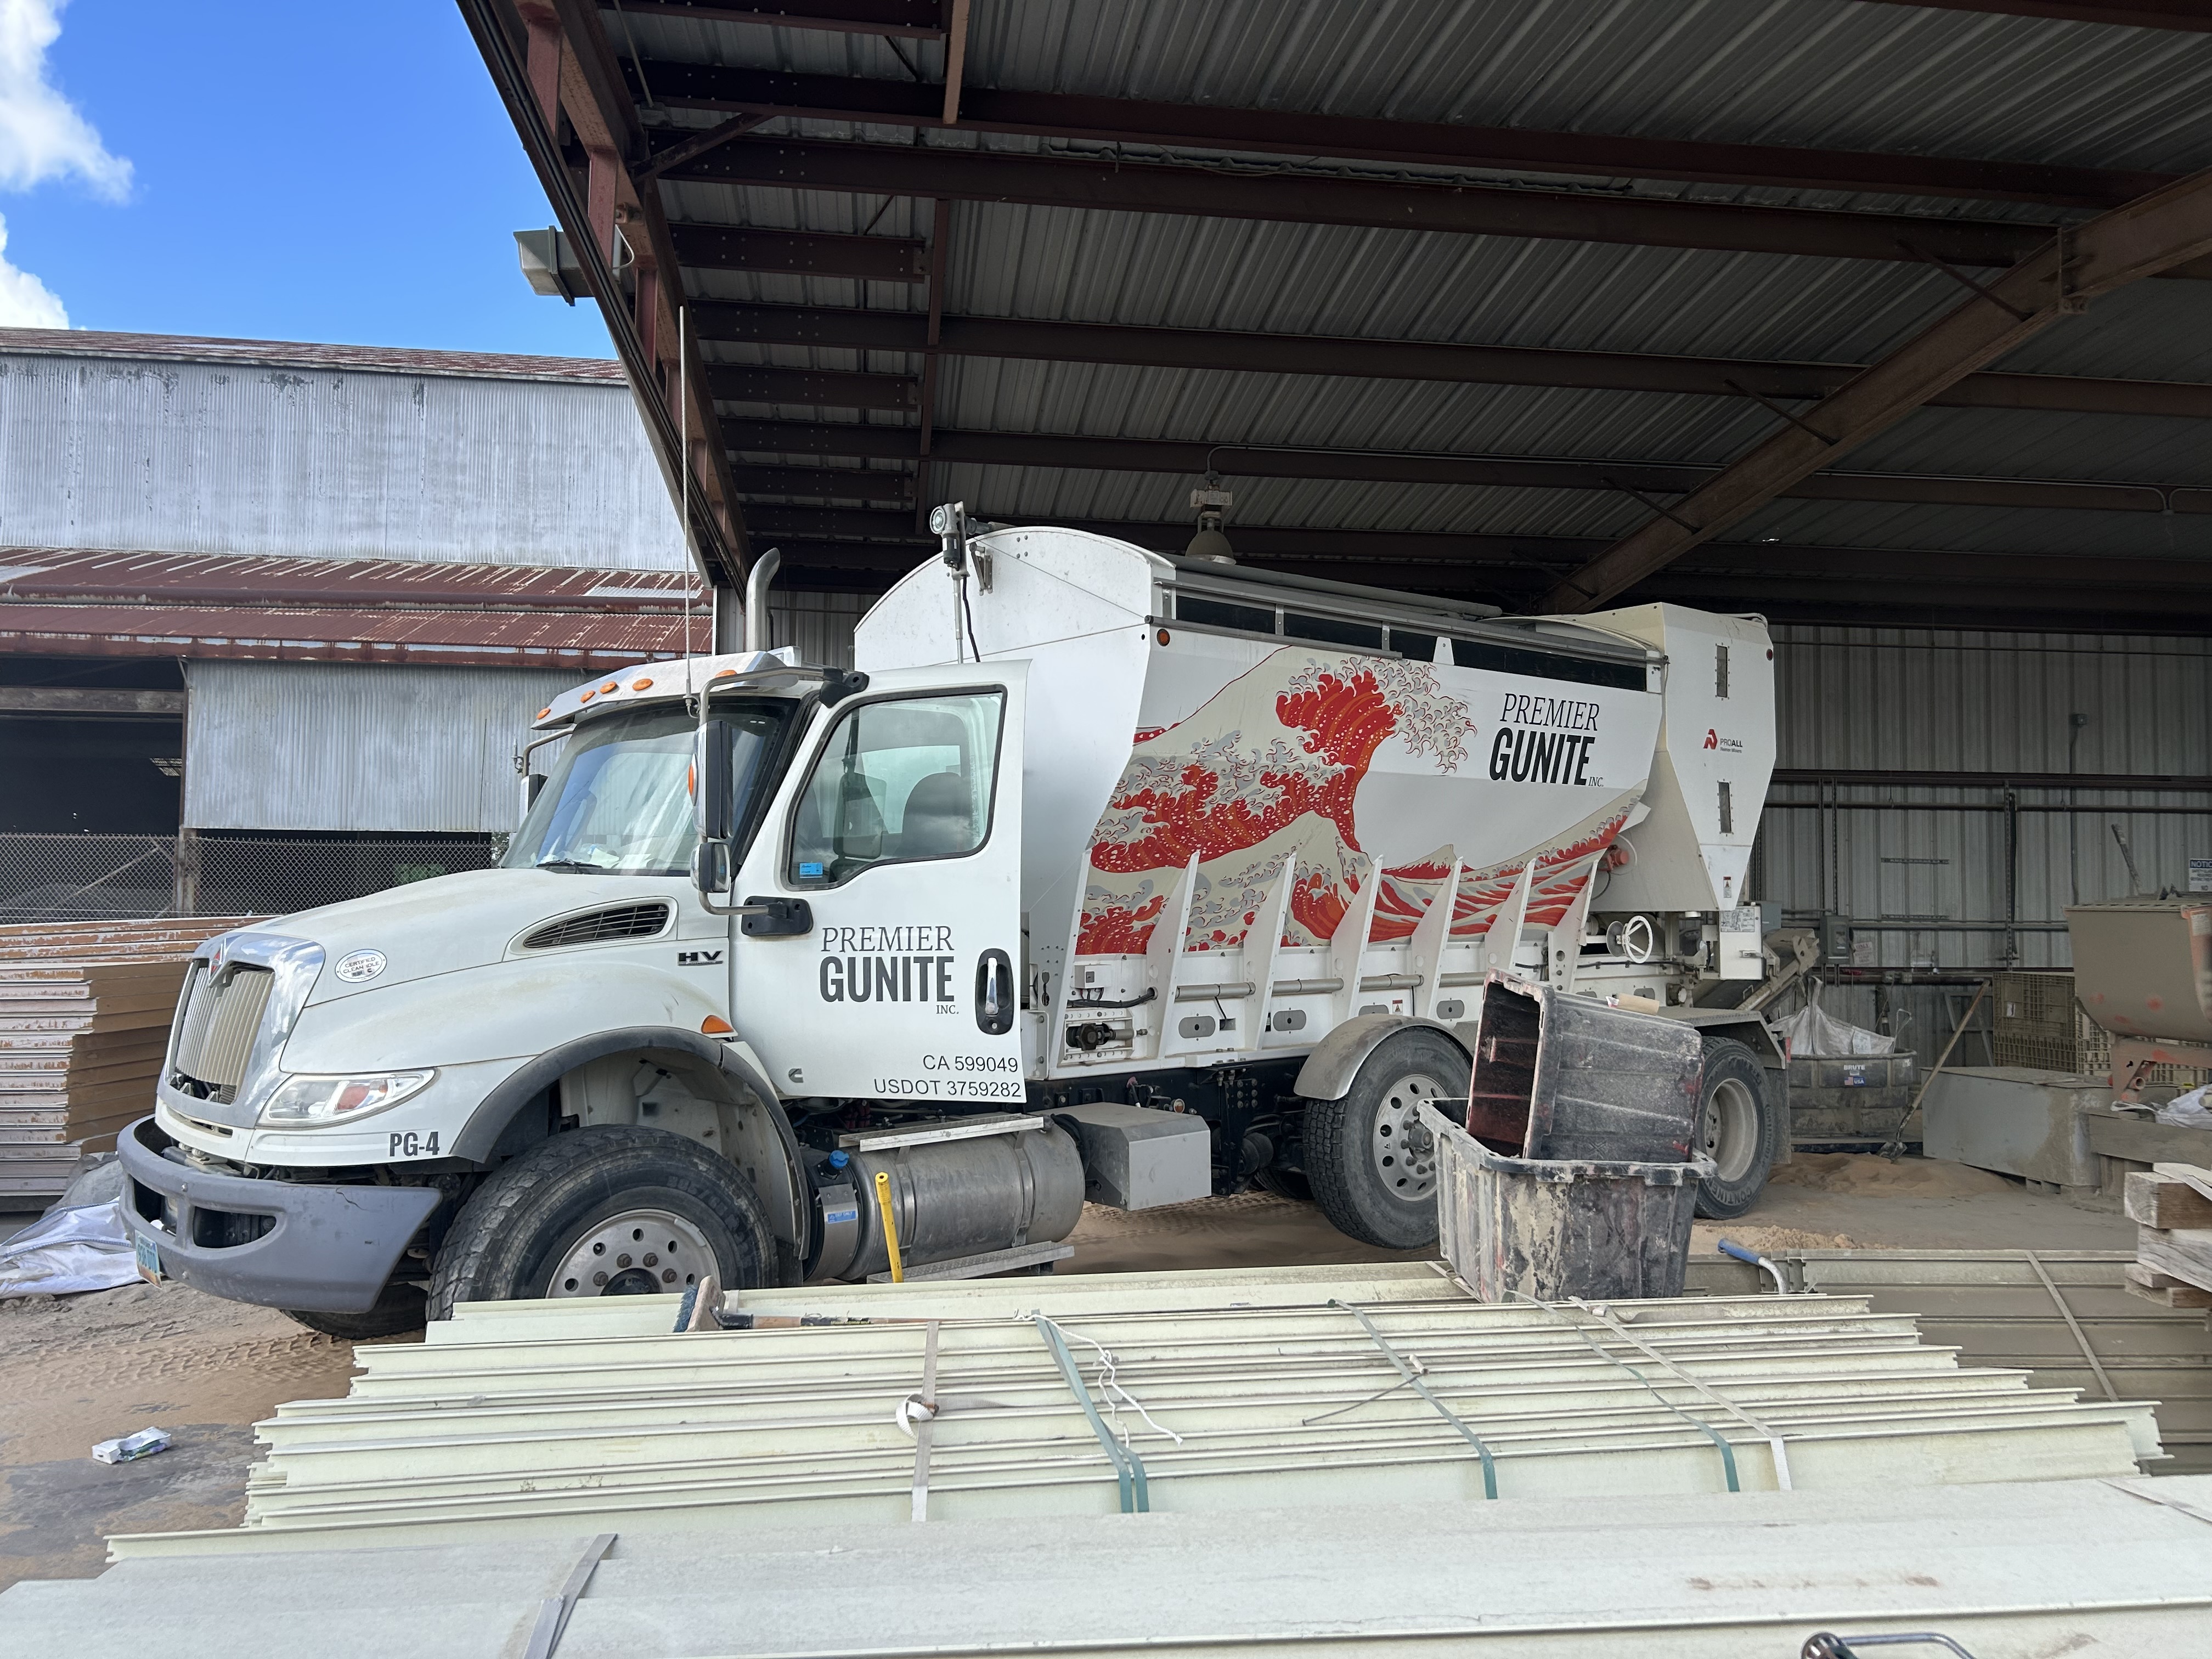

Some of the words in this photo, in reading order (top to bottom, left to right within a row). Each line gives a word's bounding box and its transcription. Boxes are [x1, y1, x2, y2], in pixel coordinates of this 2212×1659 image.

[1499, 693, 1600, 731] PREMIER
[1720, 738, 1743, 747] PROALL
[1489, 727, 1595, 786] GUNITE
[821, 926, 955, 953] PREMIER
[345, 957, 376, 968] CERTIFIED
[678, 950, 723, 962] HV
[343, 965, 364, 974] CLEAN
[820, 956, 955, 1002] GUNITE
[936, 1005, 959, 1014] INC.
[923, 1054, 950, 1070] CA
[955, 1056, 1018, 1073] 599049
[874, 1079, 941, 1095] USDOT
[947, 1081, 1022, 1097] 3759282
[390, 1131, 440, 1157] PG-4
[1705, 1177, 1753, 1205] CONTINEN
